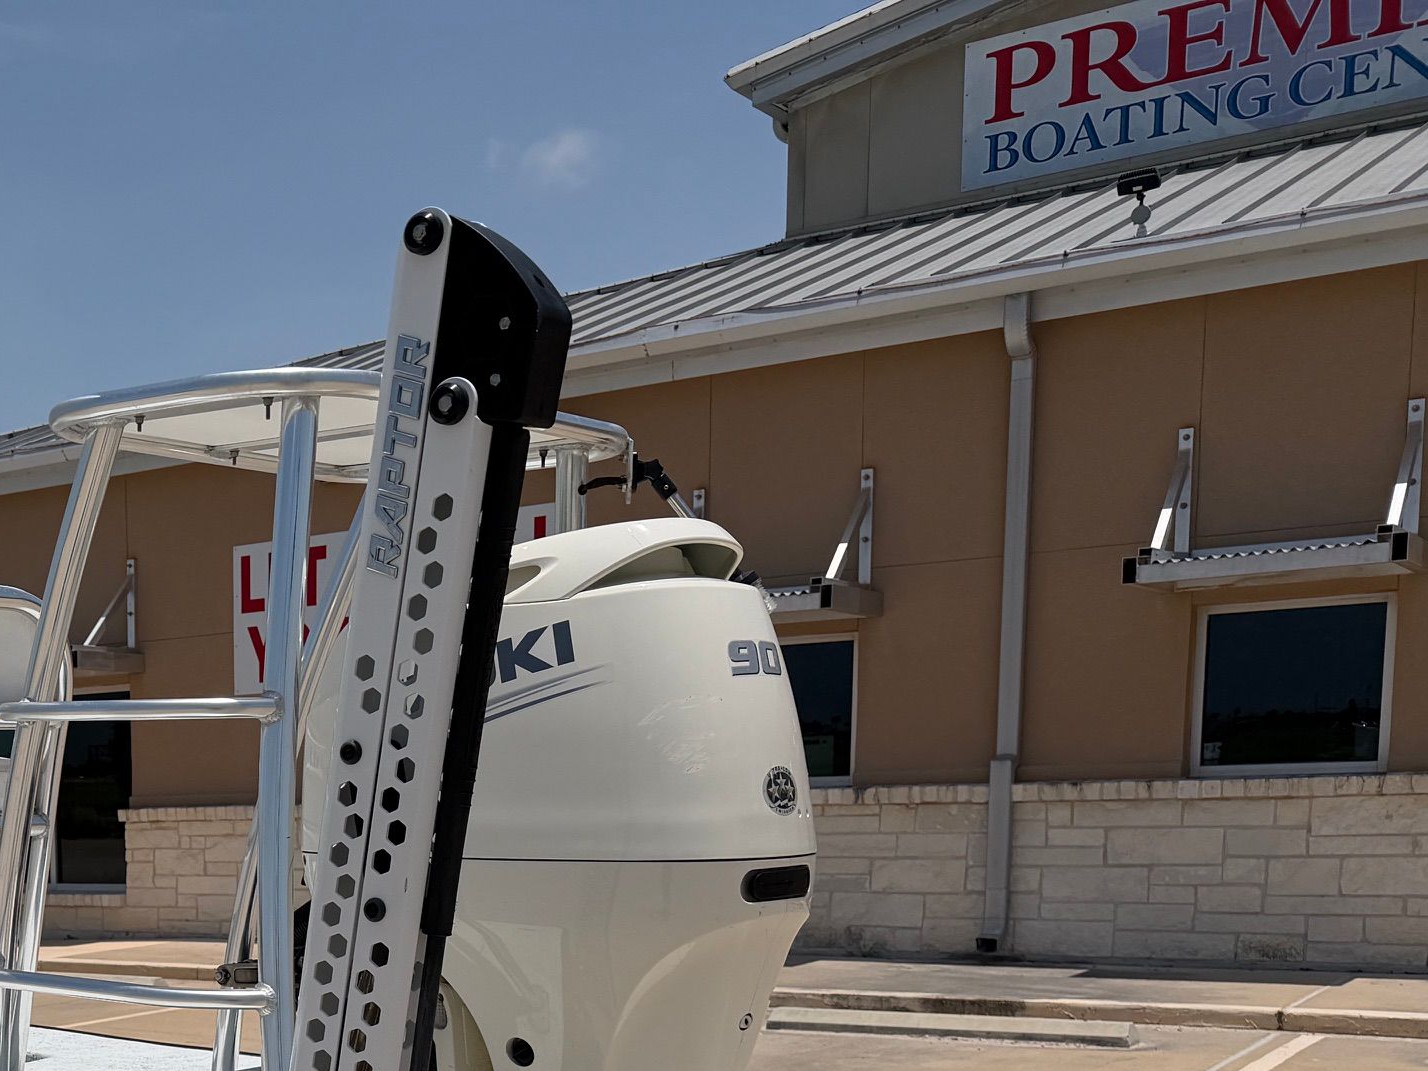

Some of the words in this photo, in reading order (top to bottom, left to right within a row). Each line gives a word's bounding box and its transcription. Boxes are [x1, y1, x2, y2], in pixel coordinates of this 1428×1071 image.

[982, 73, 1277, 174] BOATING
[1288, 38, 1428, 107] CEN
[984, 0, 1428, 126] PREMI
[366, 333, 431, 579] RAPTOR
[240, 545, 327, 614] LT
[727, 639, 782, 677] 90
